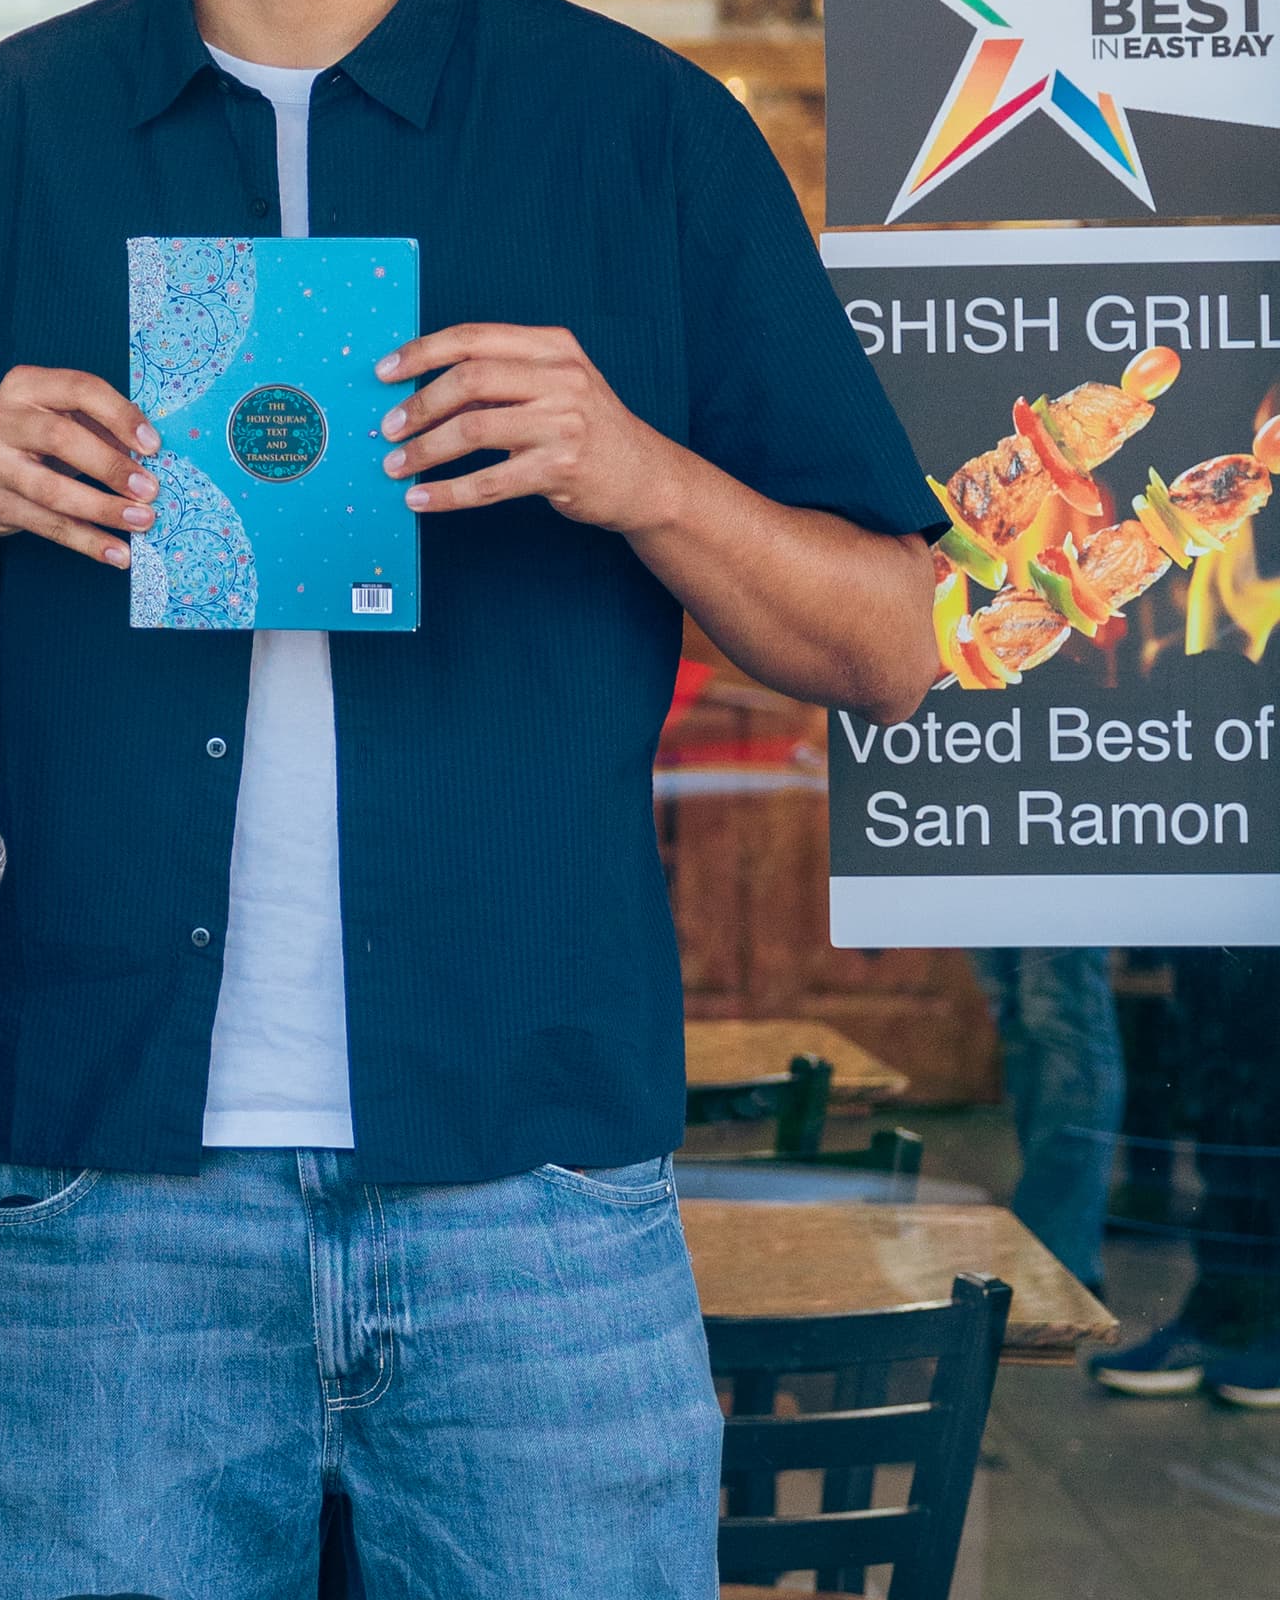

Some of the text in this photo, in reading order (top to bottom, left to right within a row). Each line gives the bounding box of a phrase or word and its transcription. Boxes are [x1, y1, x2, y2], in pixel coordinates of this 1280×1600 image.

[1211, 35, 1274, 57] BAY
[844, 294, 1280, 355] SHISH GRILL
[268, 402, 286, 411] THE
[246, 415, 271, 423] HOLY
[266, 428, 288, 436] TEXT
[266, 441, 287, 449] AND
[246, 453, 308, 462] TRANSLATION
[838, 705, 1275, 765] Voted Best of
[865, 790, 1249, 847] San Ramon
